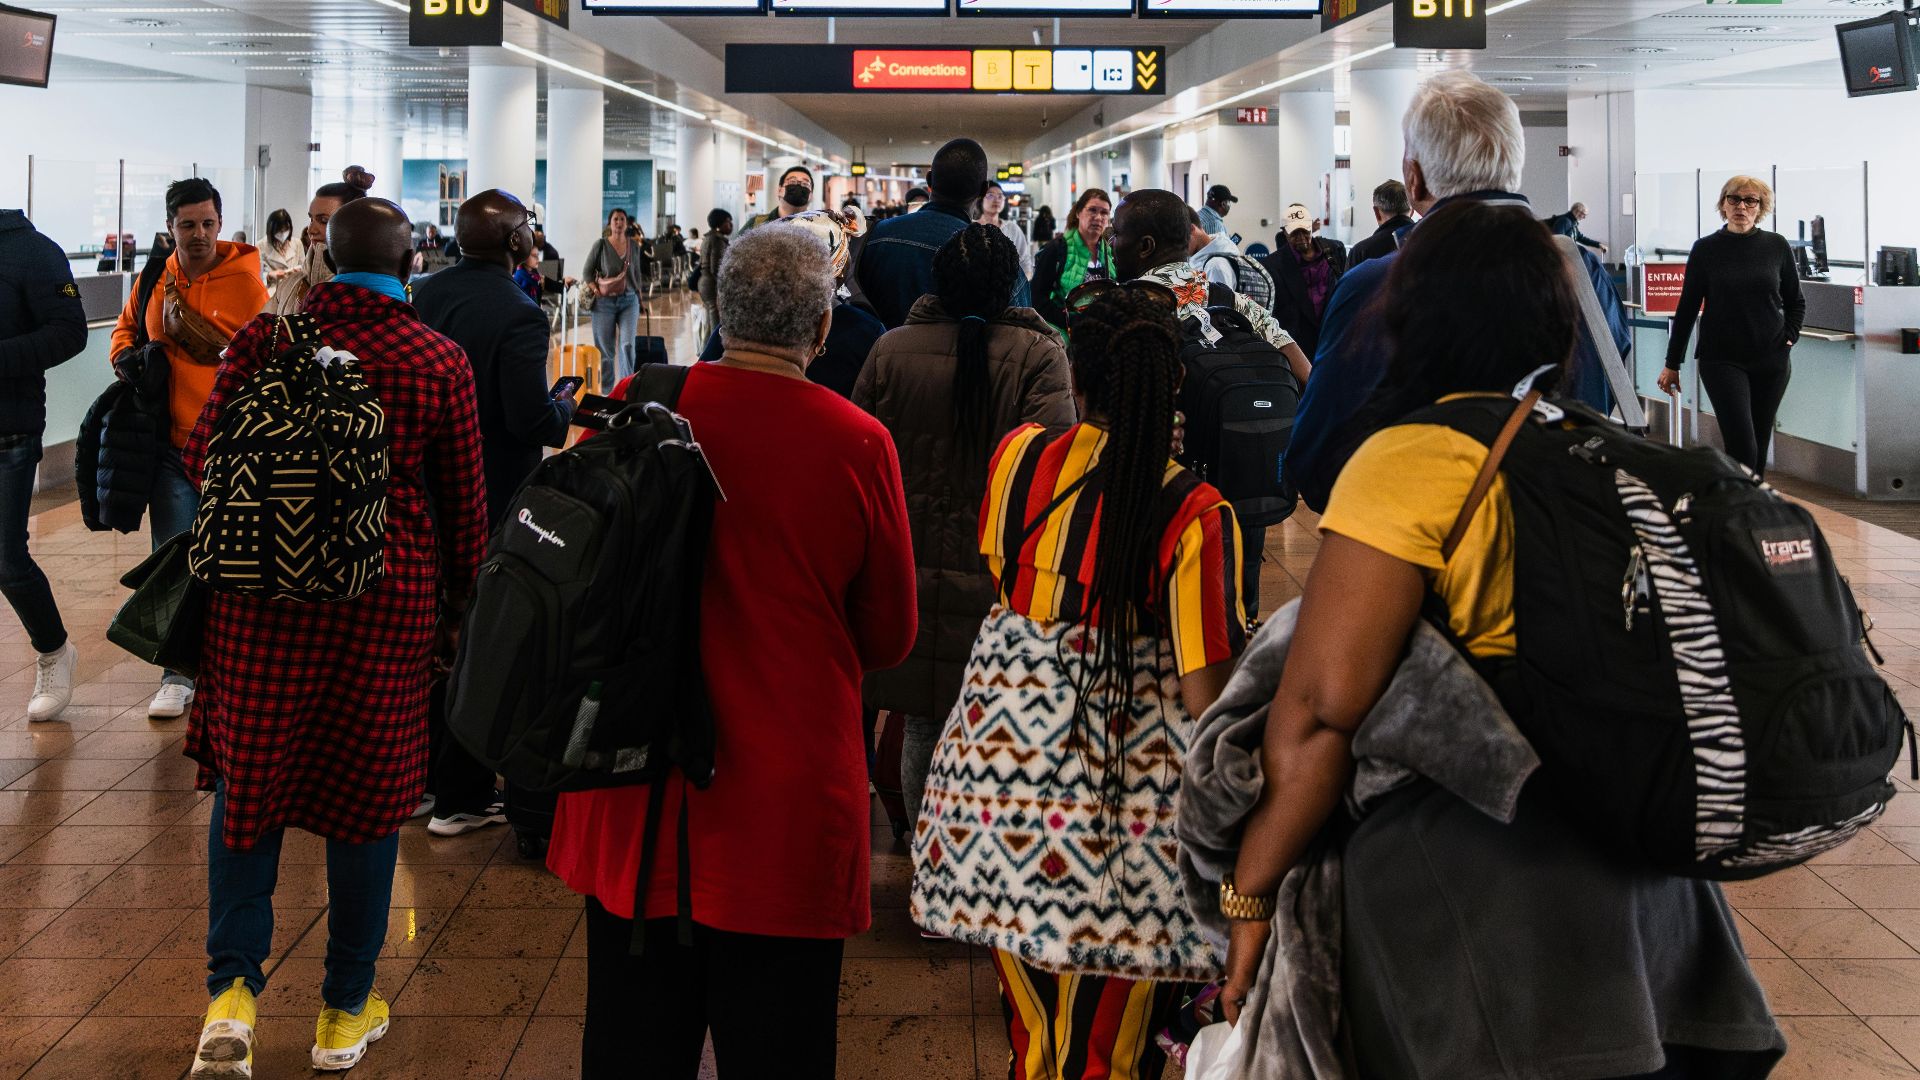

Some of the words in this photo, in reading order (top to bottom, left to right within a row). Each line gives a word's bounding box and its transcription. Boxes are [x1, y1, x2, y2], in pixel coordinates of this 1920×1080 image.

[888, 63, 966, 76] Connections
[1025, 64, 1041, 84] T
[518, 508, 566, 547] Champion
[1761, 539, 1812, 560] trans
